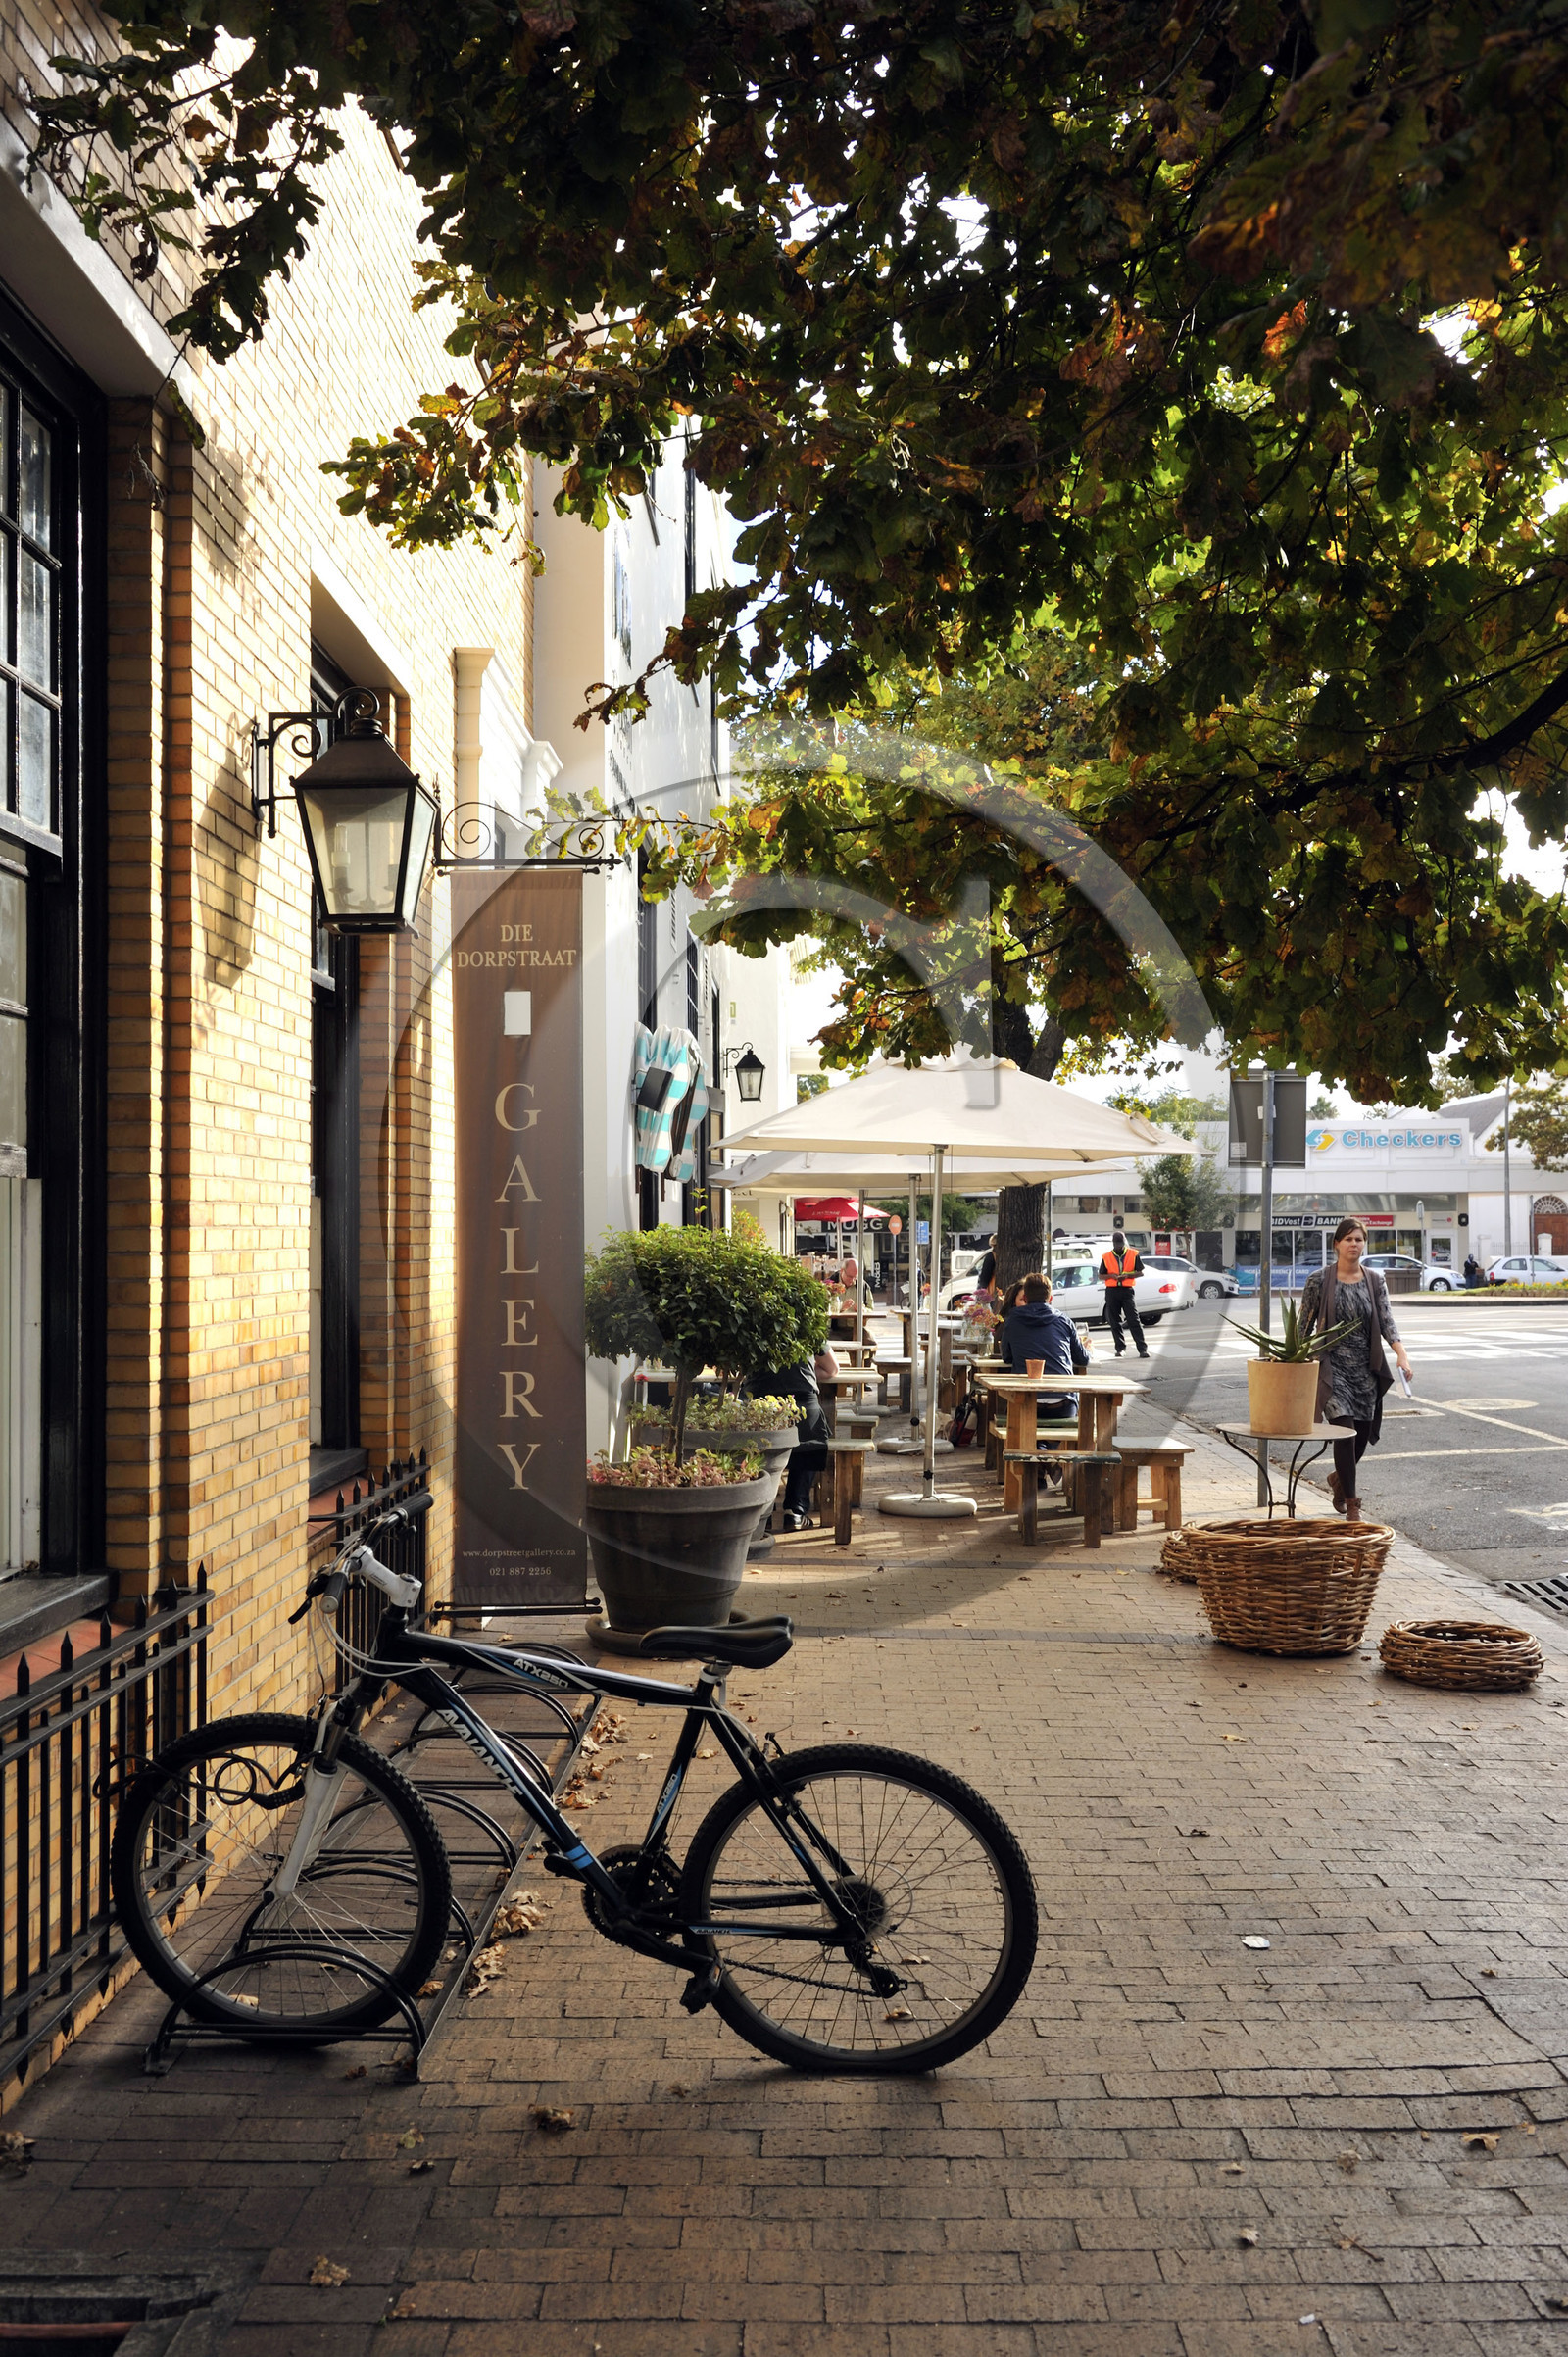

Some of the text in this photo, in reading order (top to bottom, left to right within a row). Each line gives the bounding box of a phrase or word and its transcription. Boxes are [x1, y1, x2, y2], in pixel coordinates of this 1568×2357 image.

[500, 923, 534, 944] DIE
[457, 948, 578, 968] DORPSTRAAT
[1342, 1130, 1461, 1148] Checkers
[494, 1082, 543, 1491] GALERY
[462, 1548, 576, 1559] www.dorpstreetgallery.co.za
[509, 1567, 525, 1576] 887
[528, 1566, 552, 1576] 2256
[513, 1658, 569, 1689] ATX250
